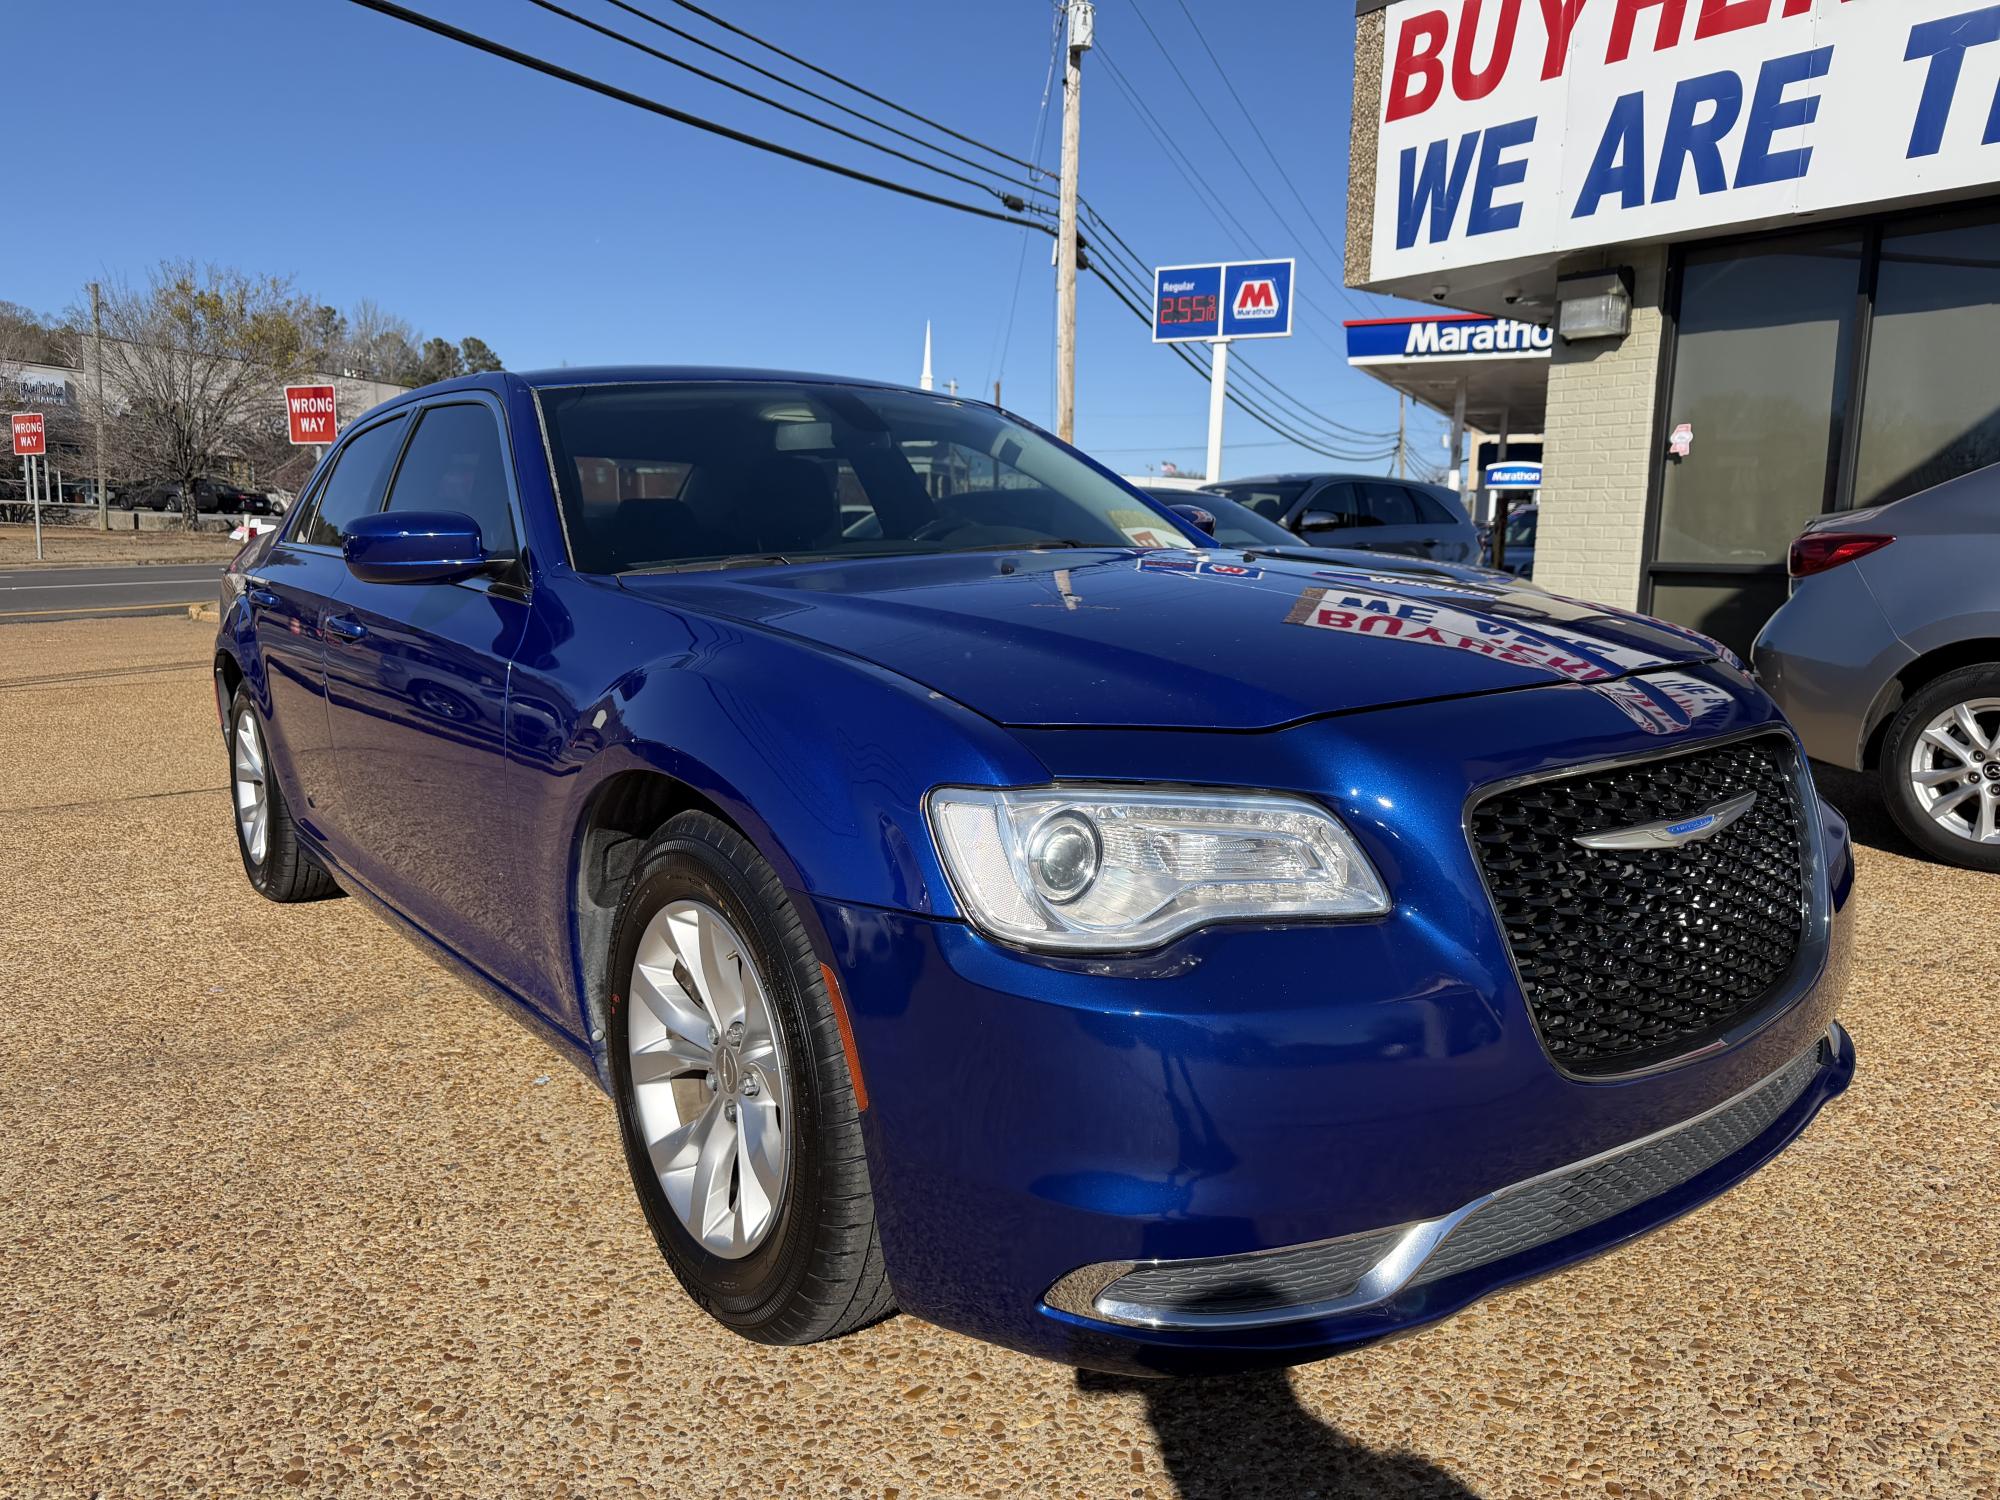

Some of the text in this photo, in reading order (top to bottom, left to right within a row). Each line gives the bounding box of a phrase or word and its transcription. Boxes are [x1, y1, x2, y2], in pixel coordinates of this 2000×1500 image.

[1396, 116, 1538, 250] WE
[1571, 45, 1834, 219] ARE
[1903, 3, 2000, 160] T
[1162, 281, 1195, 293] Regular
[1236, 308, 1275, 317] Marathon
[1404, 318, 1554, 354] Maratho
[290, 396, 333, 413] WRONG
[14, 421, 42, 434] WRONG
[300, 417, 326, 433] WAY
[20, 435, 37, 447] WAY
[1491, 471, 1540, 482] Marathon
